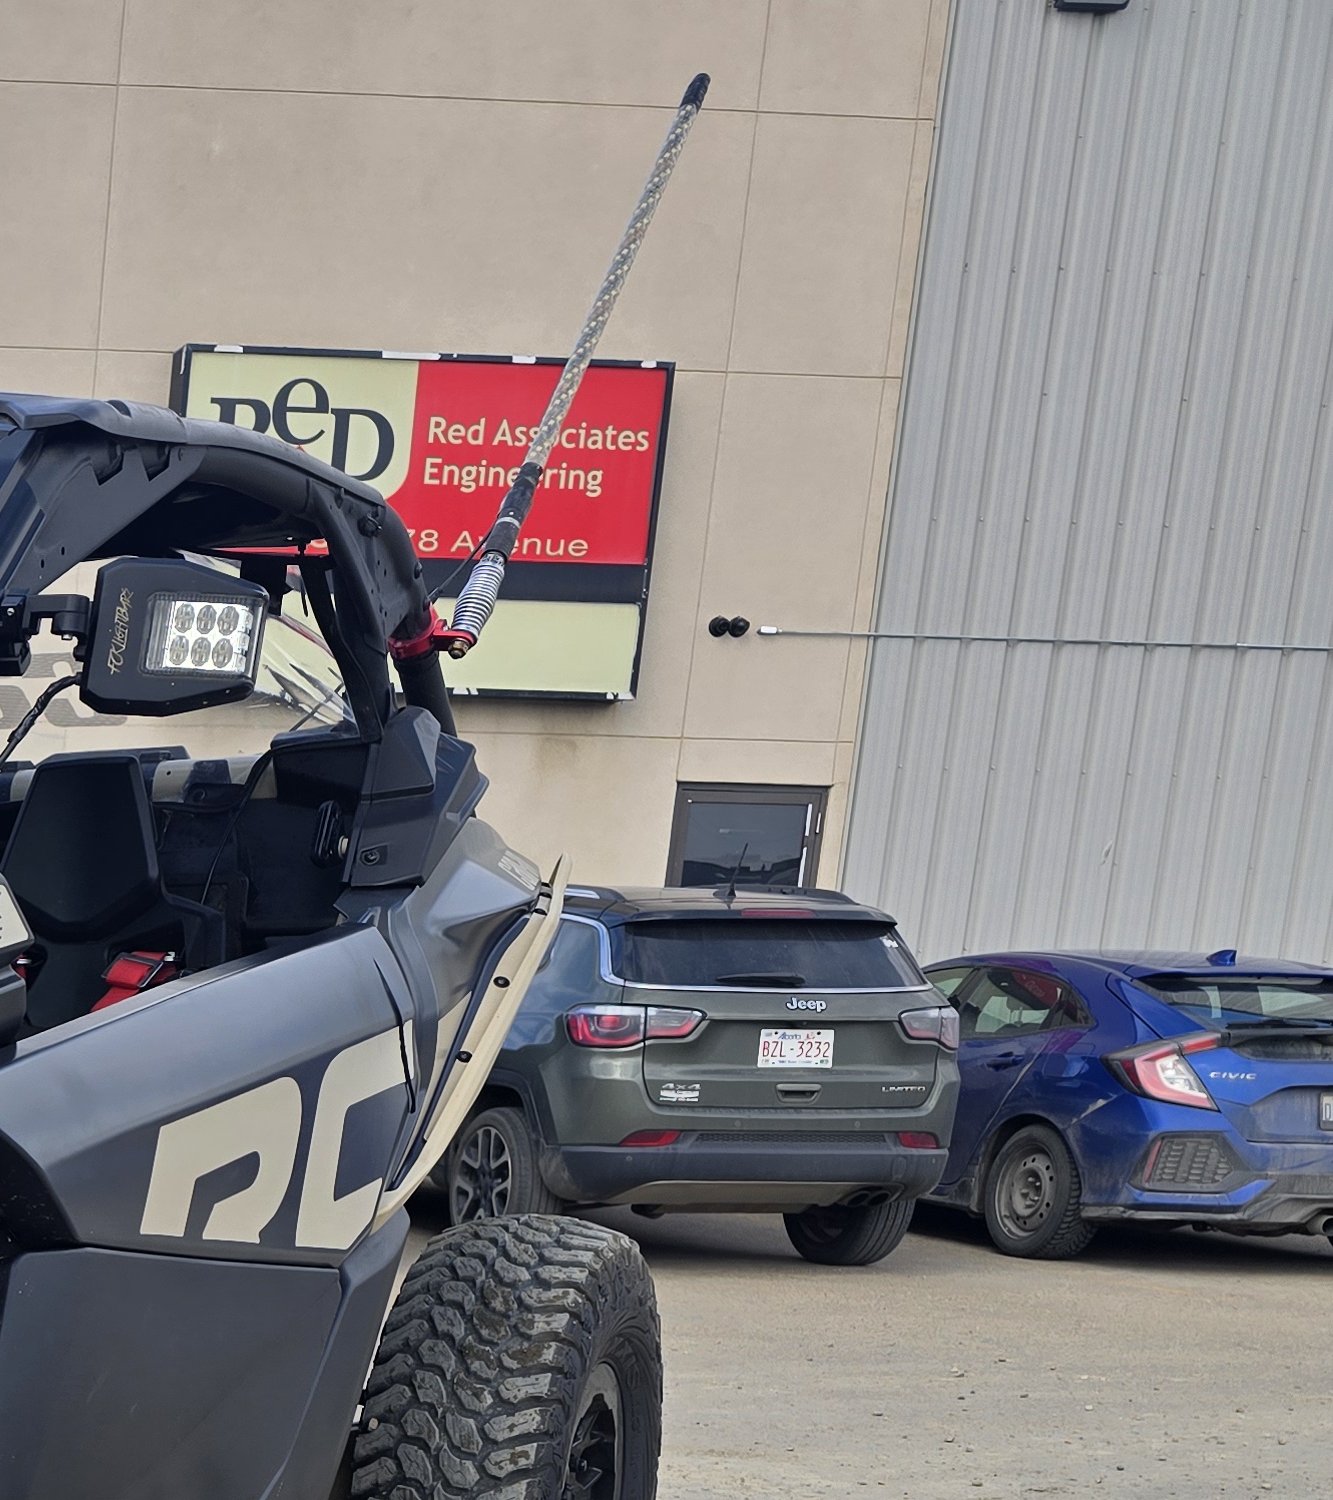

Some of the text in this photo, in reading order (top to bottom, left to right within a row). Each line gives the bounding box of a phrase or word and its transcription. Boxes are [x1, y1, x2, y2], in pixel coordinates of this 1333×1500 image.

[428, 416, 650, 452] Red Assciates
[423, 457, 604, 497] Enginering
[786, 997, 827, 1013] Jeep
[1209, 1071, 1257, 1080] CIVIC
